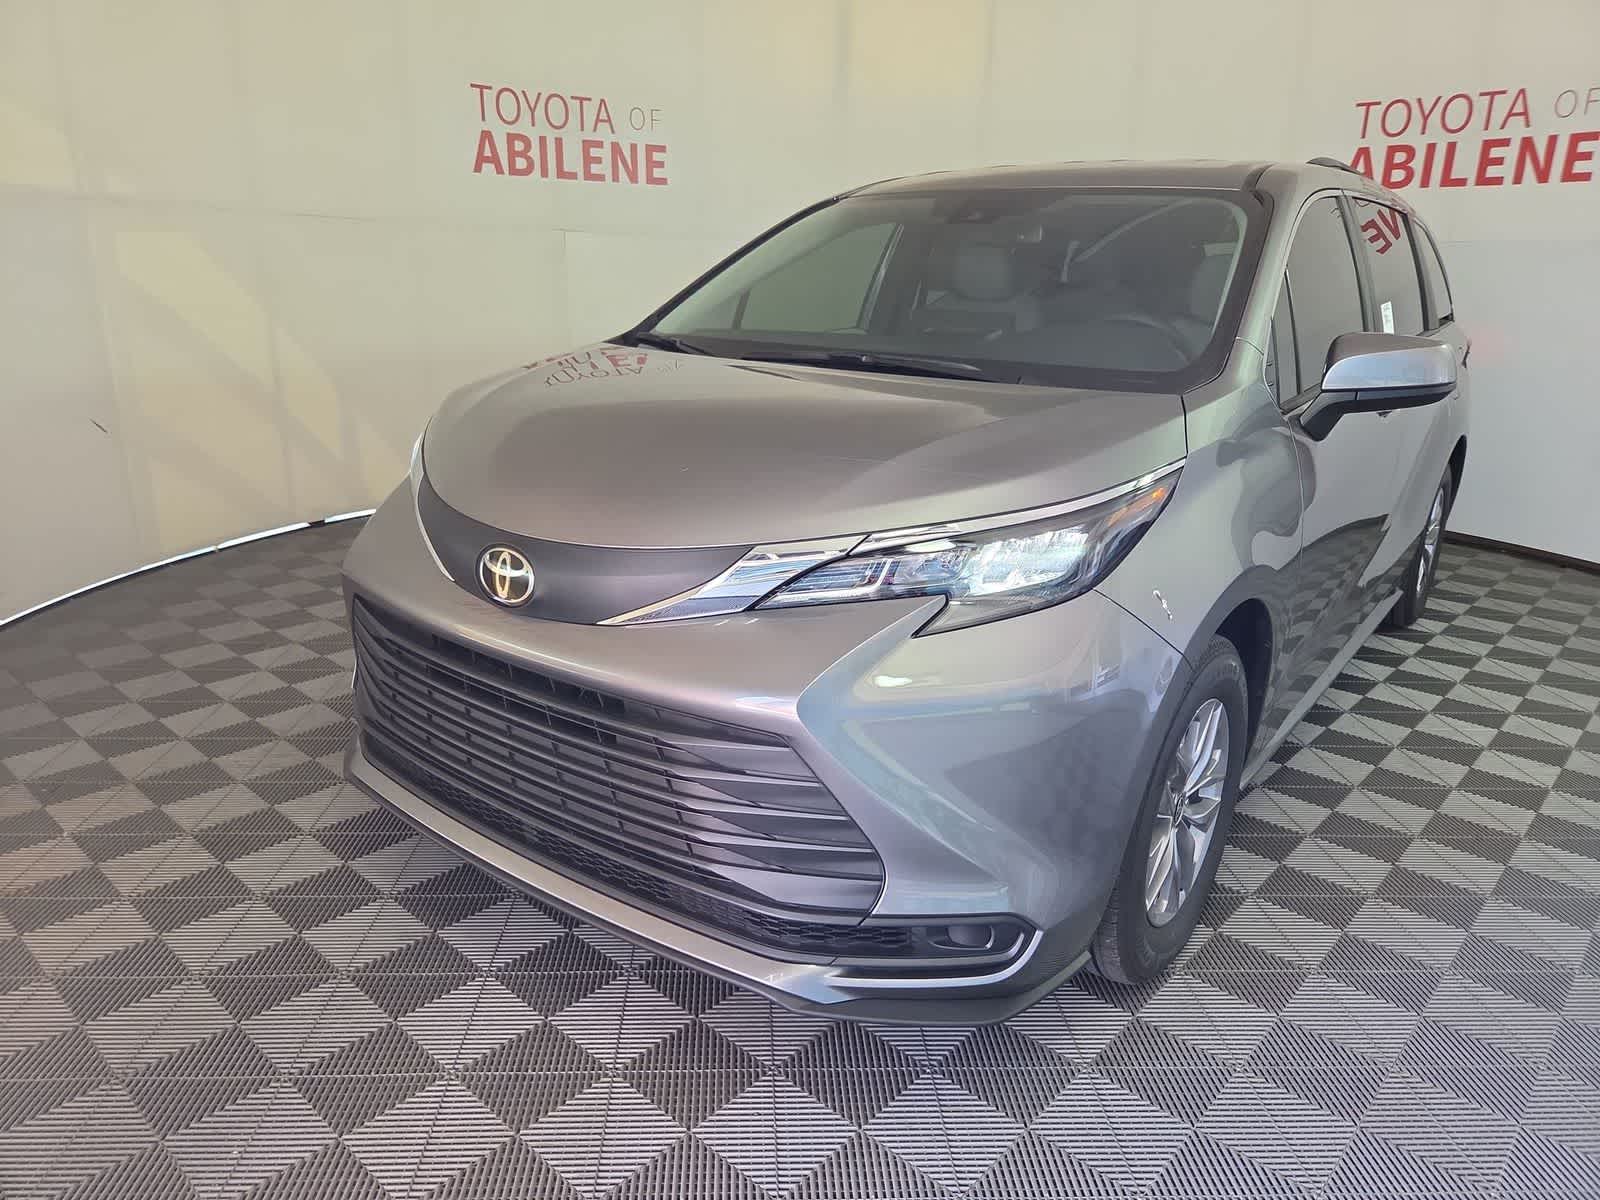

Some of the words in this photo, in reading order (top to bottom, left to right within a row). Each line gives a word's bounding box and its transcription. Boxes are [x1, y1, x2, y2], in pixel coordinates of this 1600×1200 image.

[470, 83, 615, 134] TOYOTA
[629, 106, 662, 131] OF
[1355, 88, 1531, 139] TOYOTA
[1554, 87, 1600, 118] OF
[473, 129, 669, 186] ABILENE
[1350, 131, 1600, 190] ABILENE
